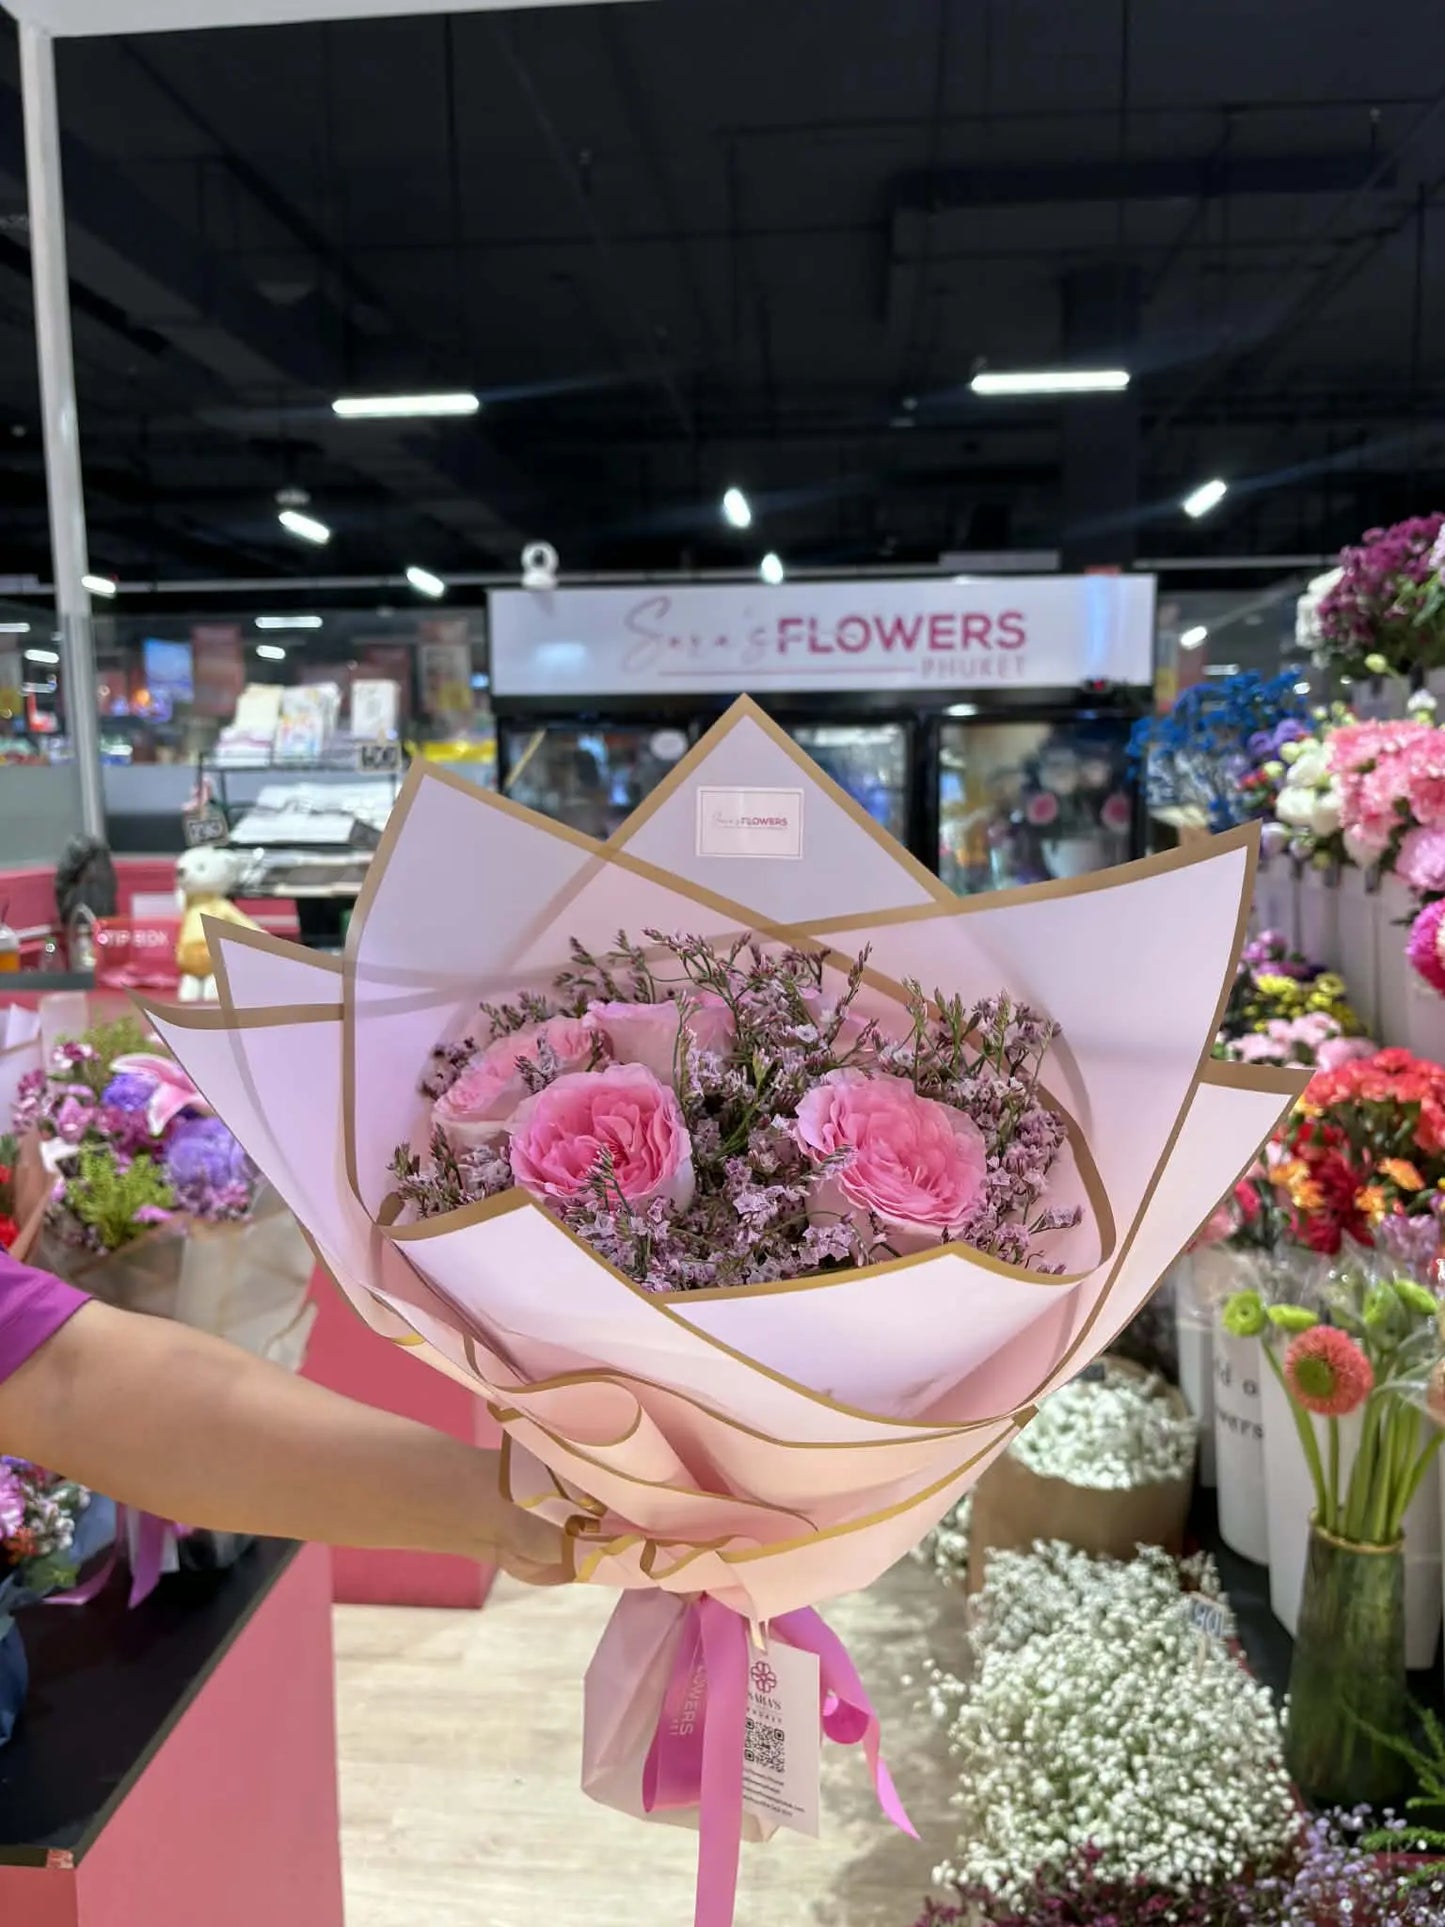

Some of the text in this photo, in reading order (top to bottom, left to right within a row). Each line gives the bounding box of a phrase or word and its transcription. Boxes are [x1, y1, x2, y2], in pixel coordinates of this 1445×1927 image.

[776, 610, 1027, 654] FLOWERS
[921, 656, 1026, 679] PHUKET
[740, 816, 788, 827] FLOWERS
